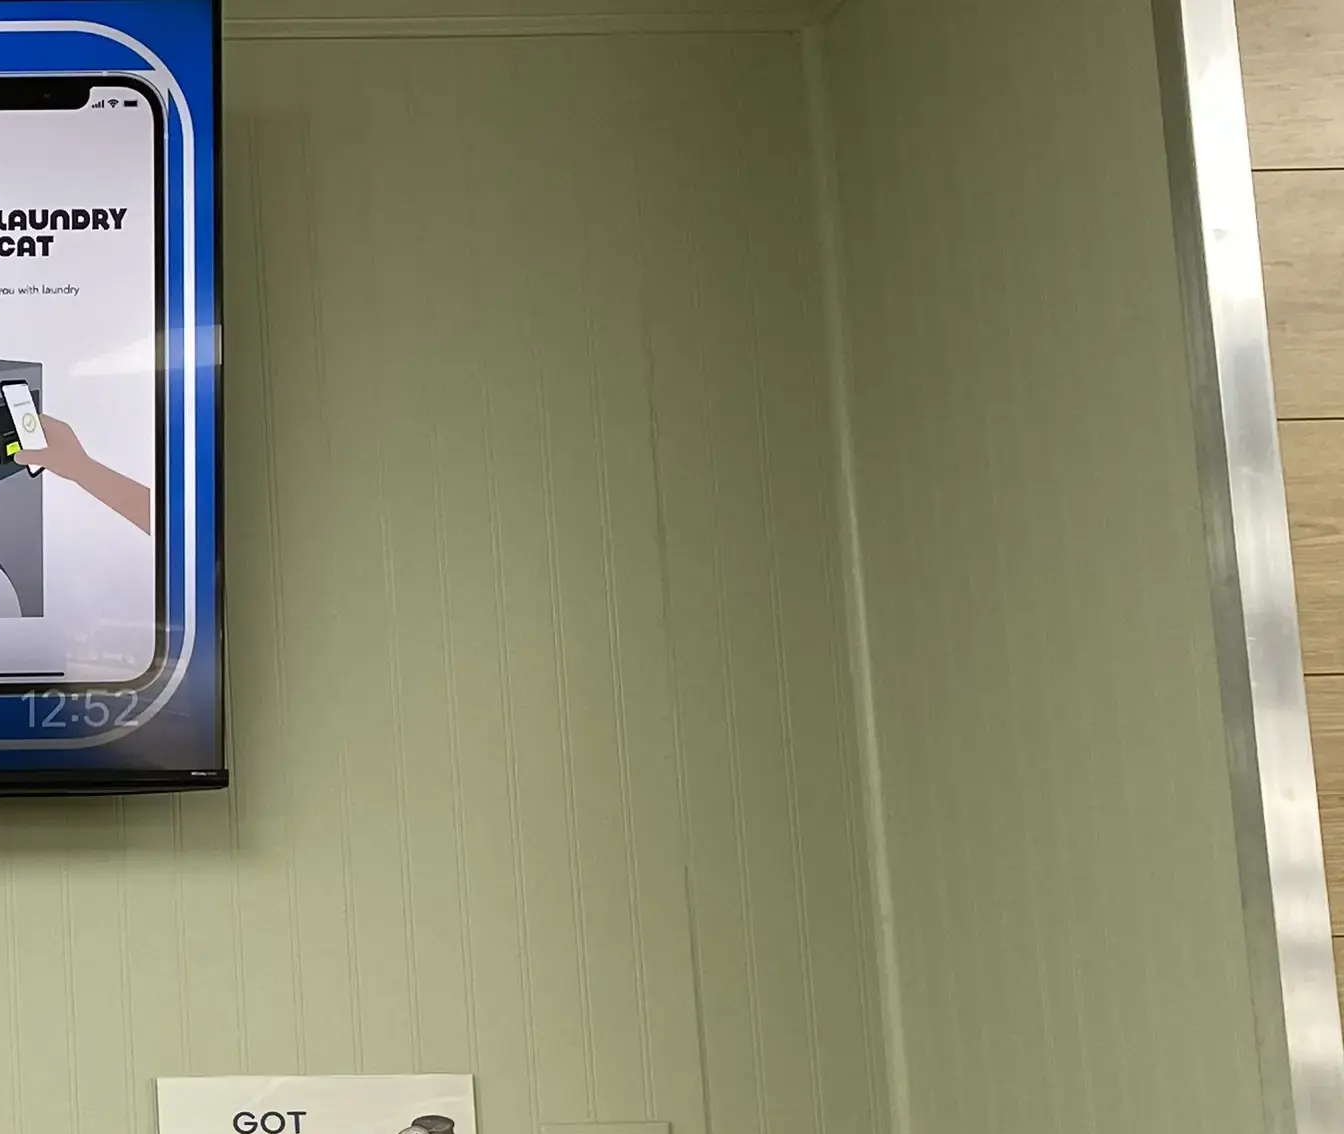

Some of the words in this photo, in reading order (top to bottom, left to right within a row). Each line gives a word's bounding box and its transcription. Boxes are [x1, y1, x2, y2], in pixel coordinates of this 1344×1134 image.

[18, 285, 38, 295] with
[42, 284, 80, 296] laundry
[21, 689, 139, 728] 12:52
[232, 1111, 307, 1134] GOT
